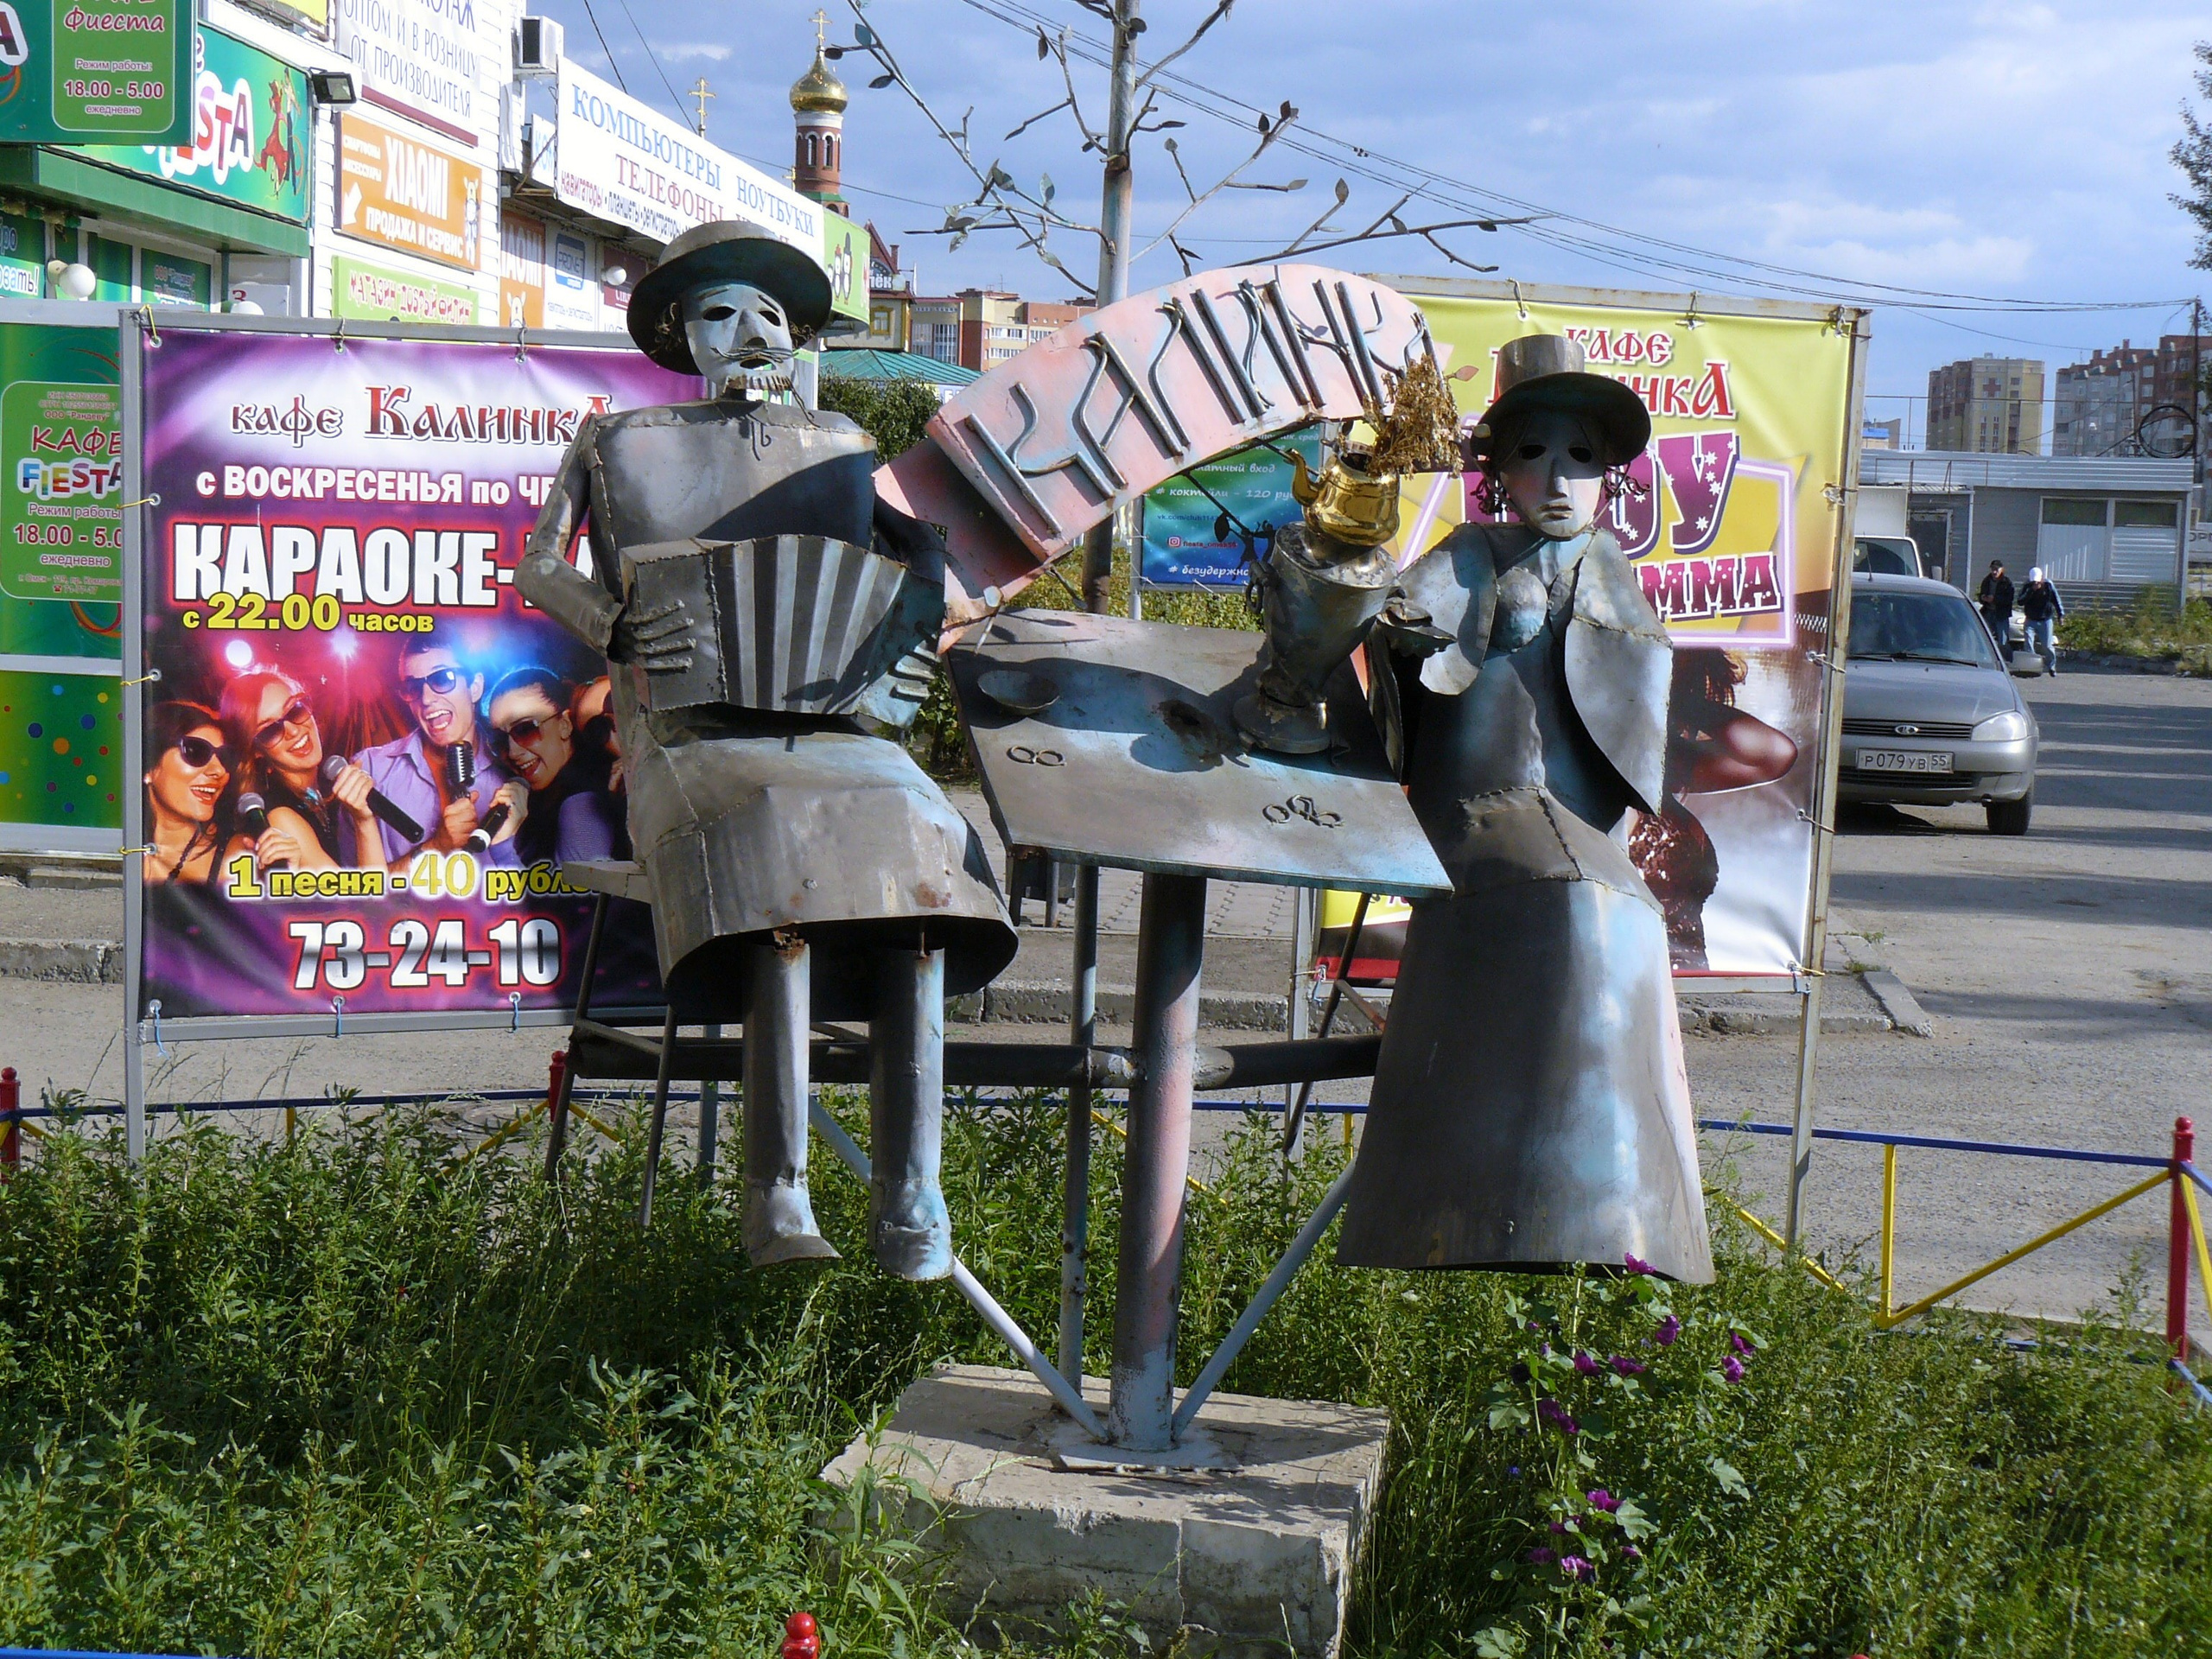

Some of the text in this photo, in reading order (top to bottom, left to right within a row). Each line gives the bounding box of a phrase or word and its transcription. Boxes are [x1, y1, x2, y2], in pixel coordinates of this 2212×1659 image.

[65, 7, 163, 31] Фиеста
[397, 15, 405, 45] И
[413, 22, 418, 51] В
[76, 60, 152, 71] Режим работы:
[352, 35, 470, 118] ОТ ПРОИЗВОДИТЕЛЯ
[65, 81, 110, 96] 18.00
[128, 83, 163, 98] 5.00
[86, 105, 141, 116] ежедневно
[385, 135, 448, 220] XIAOMI
[572, 84, 721, 191] КОМПЬЮТЕРЫ
[736, 175, 814, 238] НОУТБУКИ
[615, 154, 723, 223] ТЕЛЕФОНЫ
[365, 206, 464, 258] ПРОДАЖА И СЕРВИС
[196, 469, 216, 498] с
[224, 466, 462, 504] ВОСКРЕСЕНЬЯ
[472, 480, 510, 505] по
[1246, 489, 1271, 499] 120
[29, 504, 71, 516] Режим
[15, 524, 73, 545] 18.00
[41, 554, 111, 567] ежедневно
[183, 593, 435, 632] с 22.00 часов
[1931, 754, 1948, 766] 55
[229, 855, 261, 897] 1
[270, 872, 383, 896] песня
[411, 853, 476, 897] 40
[486, 861, 601, 900] рубл
[289, 919, 560, 989] 73-24-10
